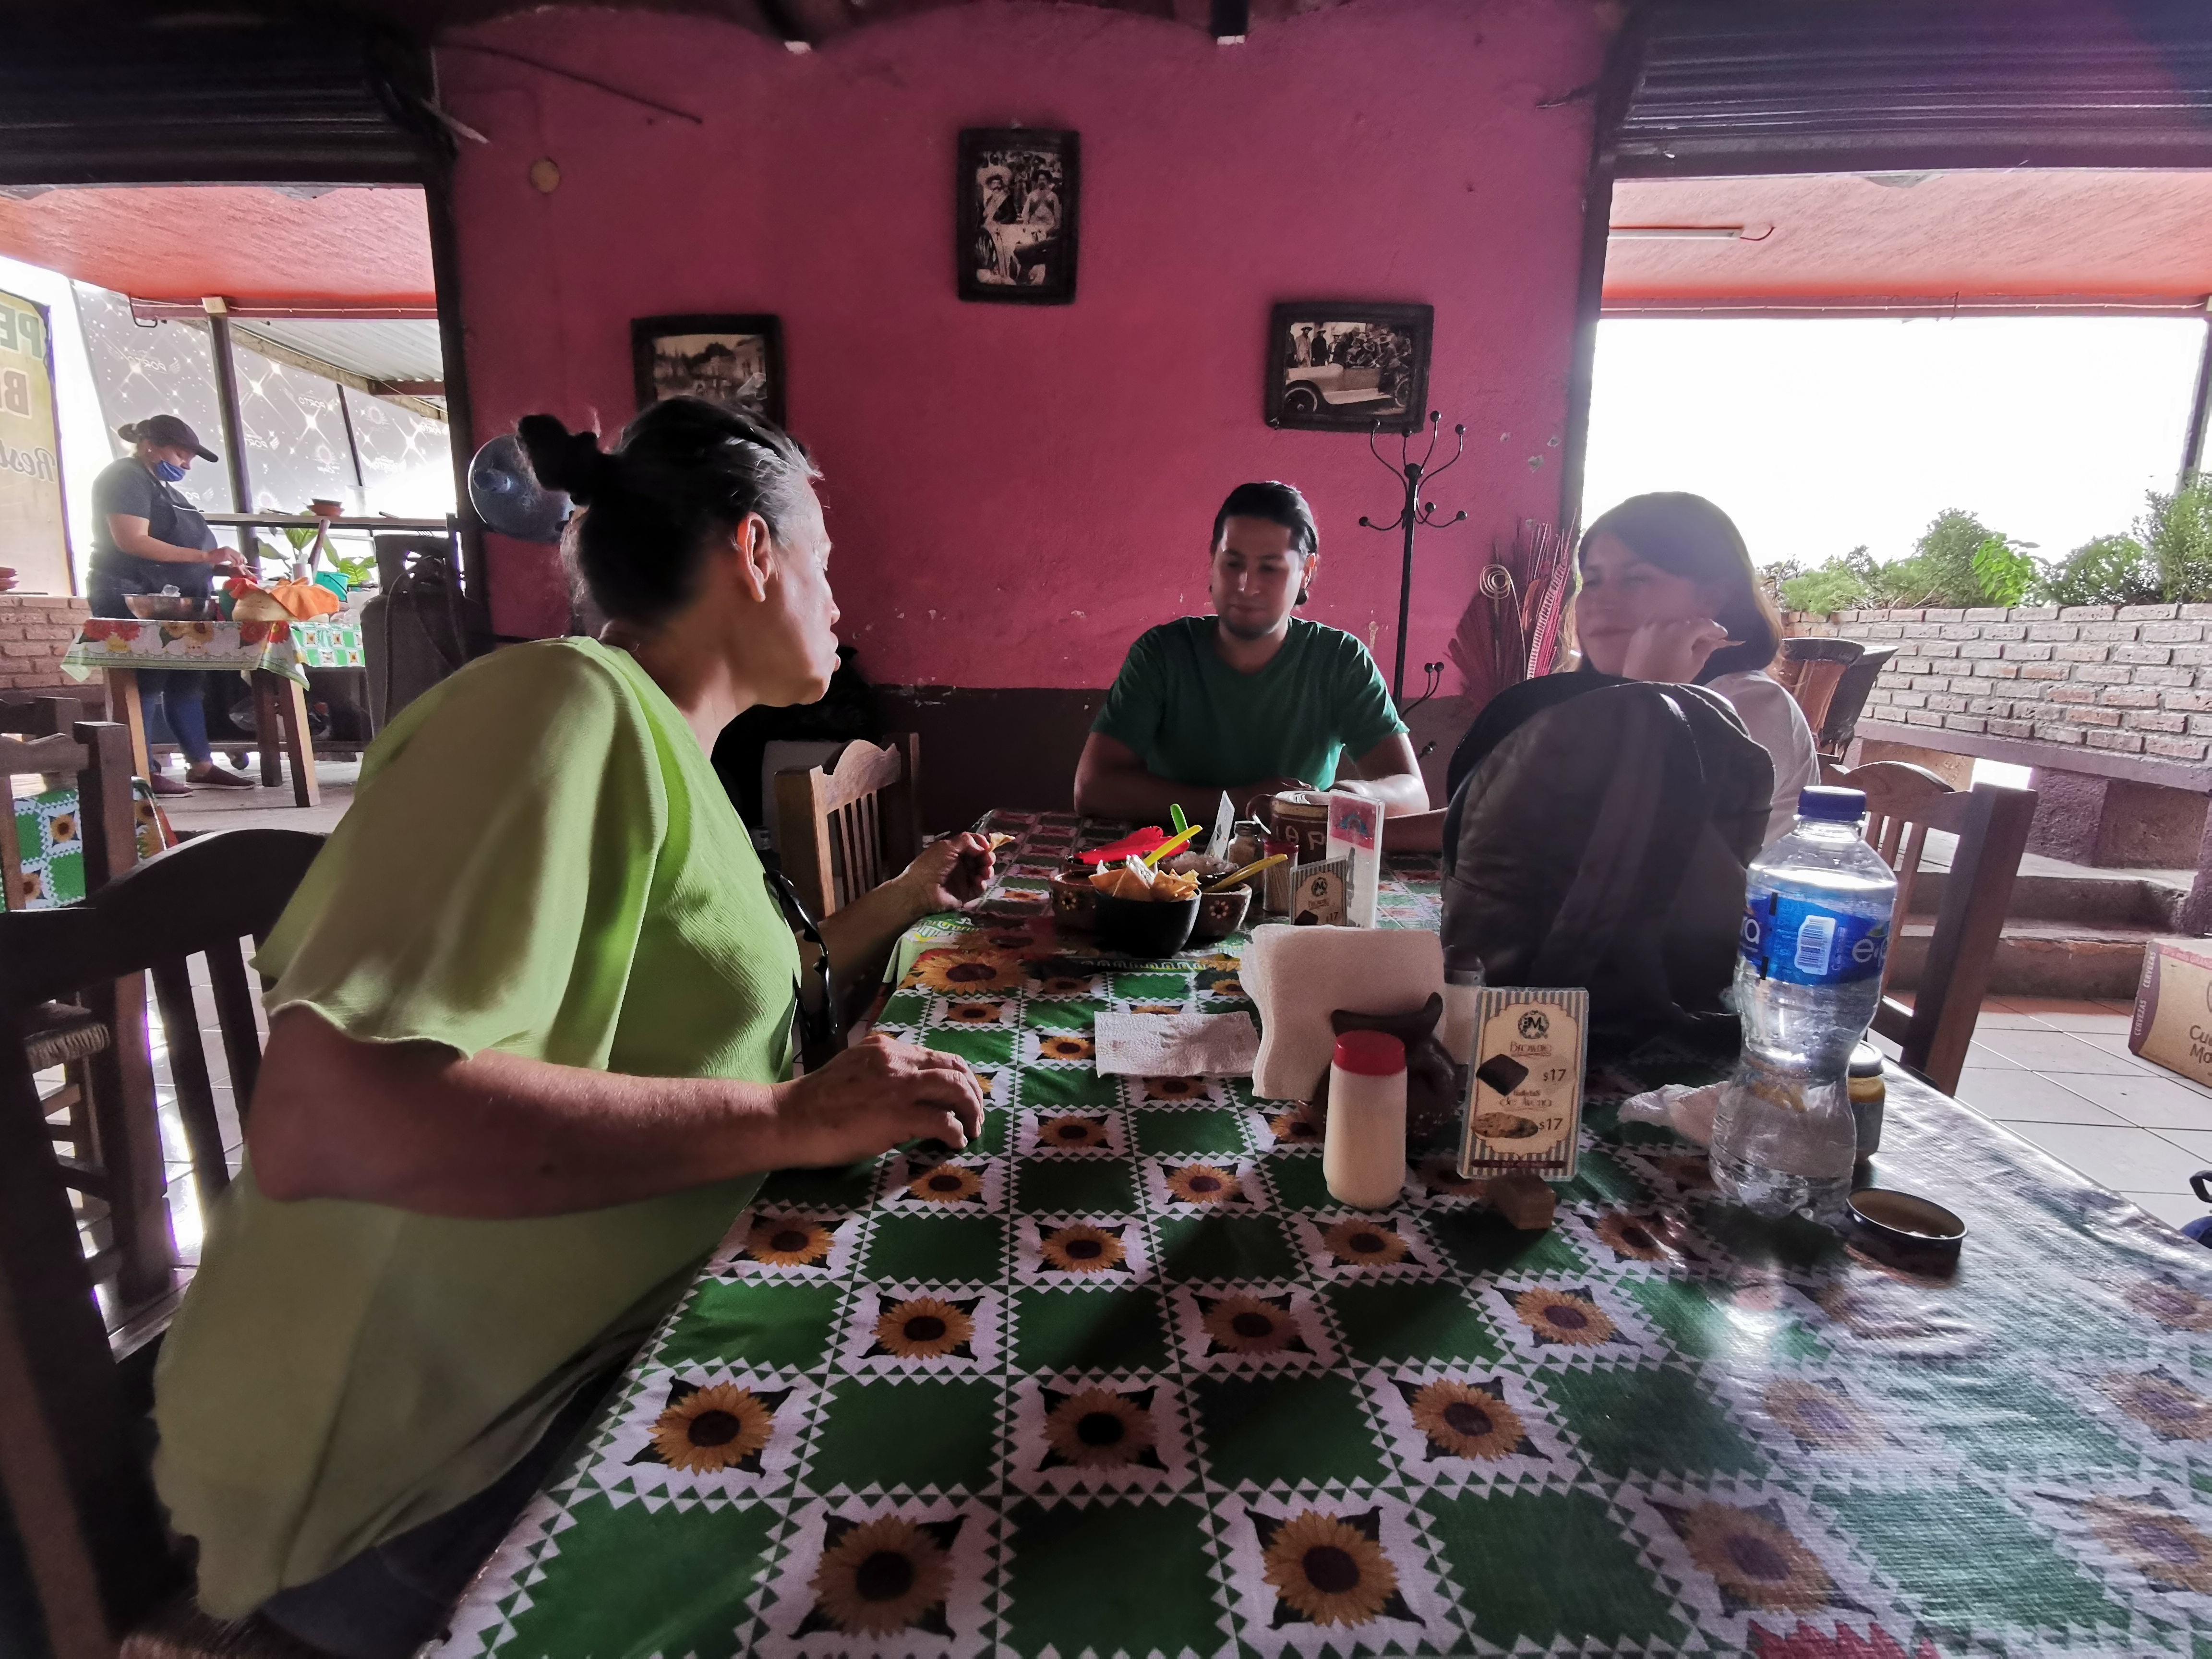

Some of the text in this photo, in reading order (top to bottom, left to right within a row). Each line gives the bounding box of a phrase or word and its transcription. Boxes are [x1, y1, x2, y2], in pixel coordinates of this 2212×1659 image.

[2142, 951, 2156, 988] CERVEZAS
[2133, 999, 2147, 1036] CERVEZAS
[1543, 1068, 1566, 1082] $17
[1539, 1118, 1563, 1131] $17
